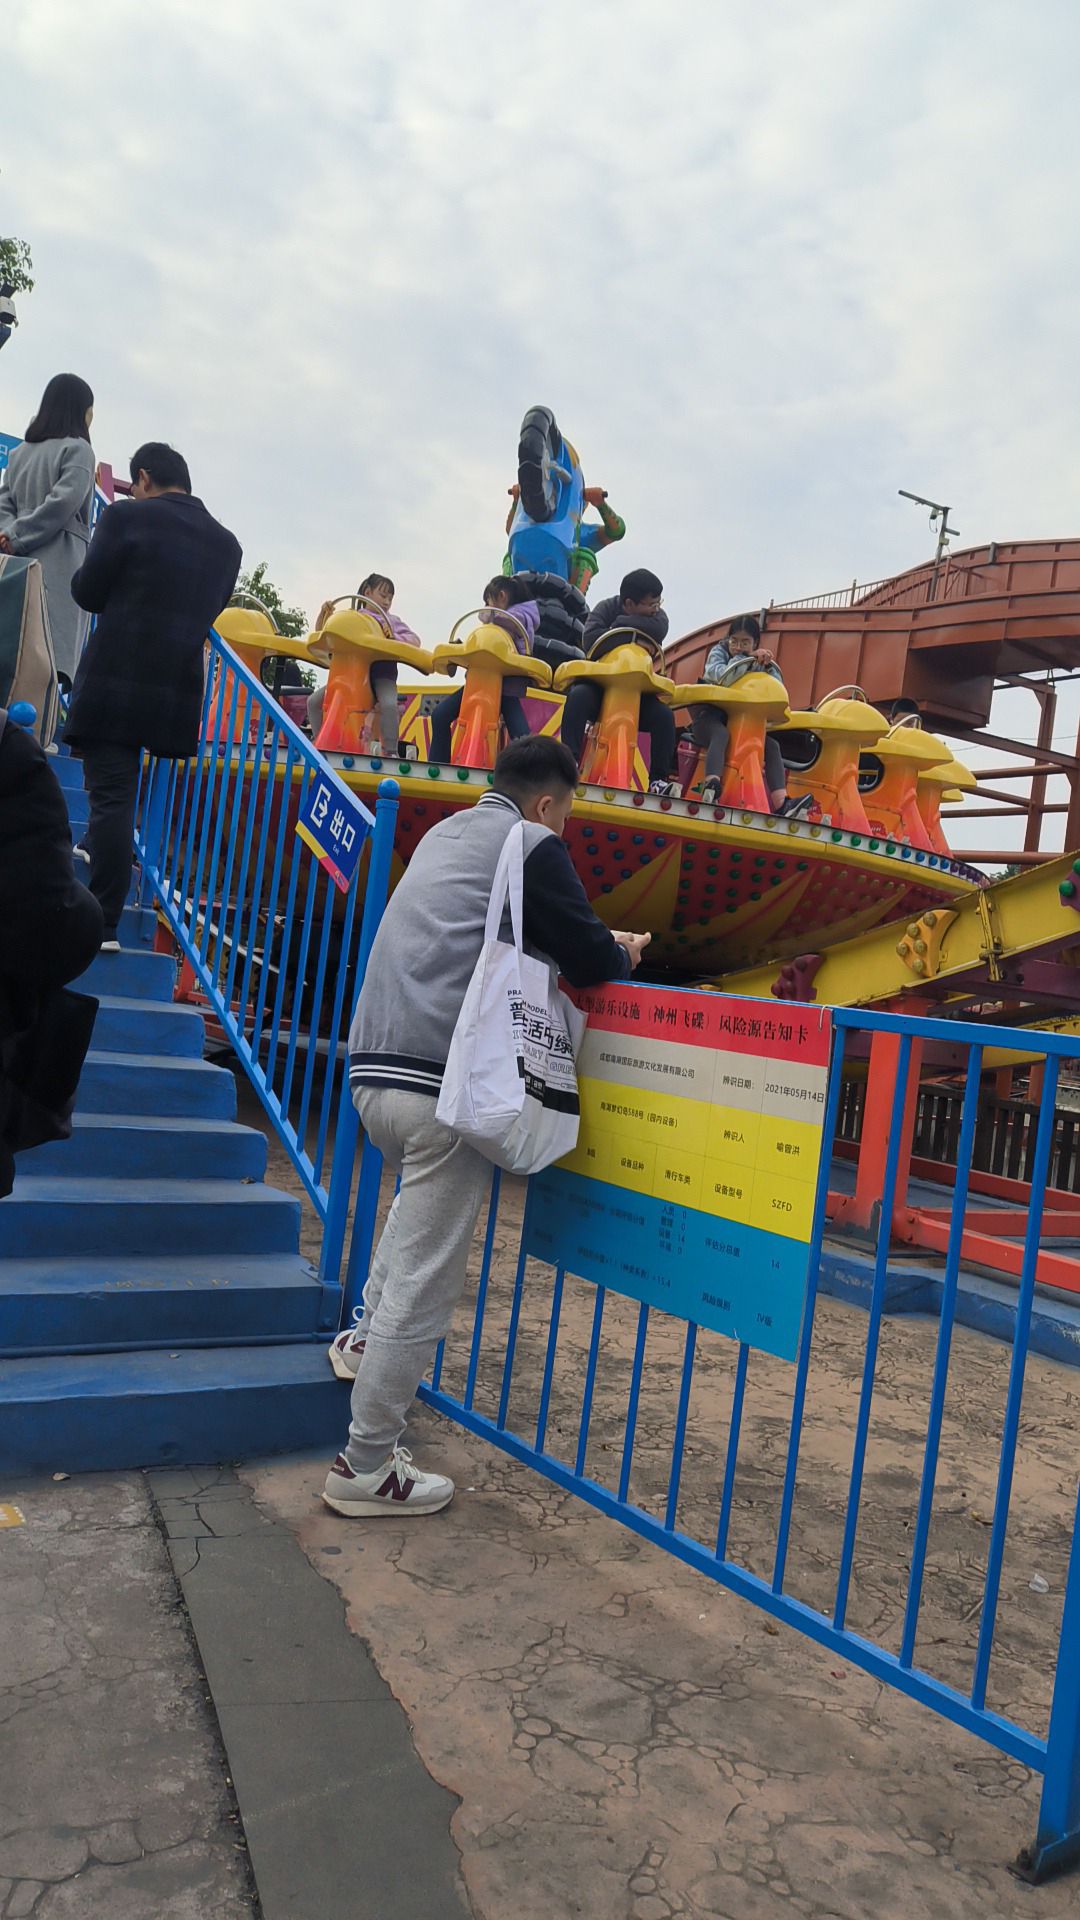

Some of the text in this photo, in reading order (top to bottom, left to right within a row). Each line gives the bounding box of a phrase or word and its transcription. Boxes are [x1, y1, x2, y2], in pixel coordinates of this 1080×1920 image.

[329, 808, 356, 853] 出口
[764, 1083, 825, 1104] 2021年05月14日
[714, 1183, 743, 1200] 设备型号
[771, 1198, 793, 1213] SZFD
